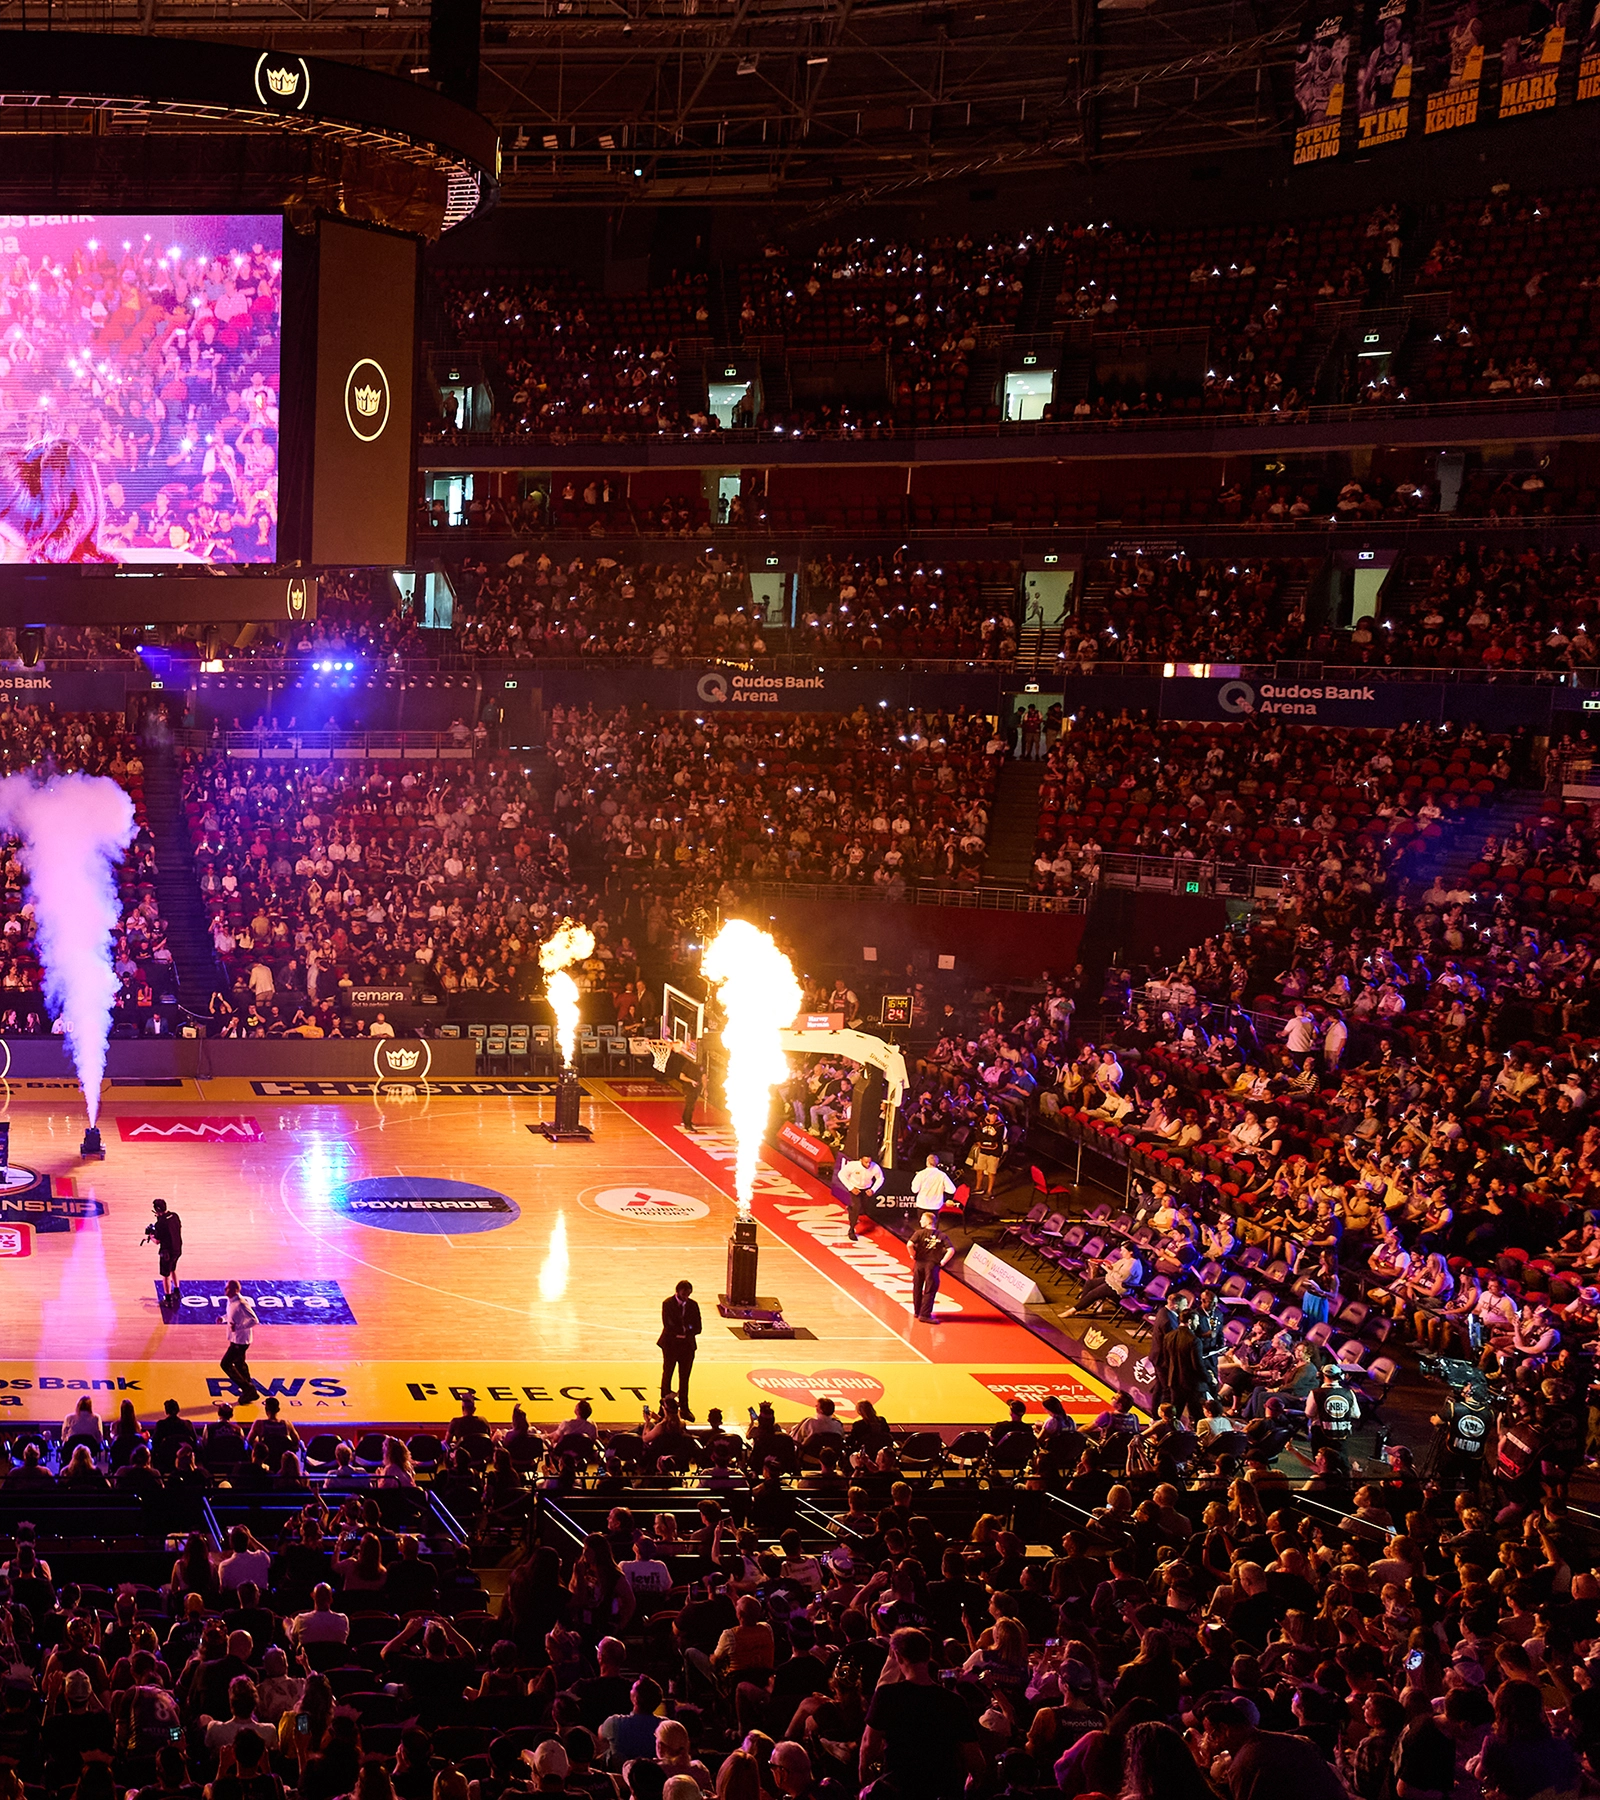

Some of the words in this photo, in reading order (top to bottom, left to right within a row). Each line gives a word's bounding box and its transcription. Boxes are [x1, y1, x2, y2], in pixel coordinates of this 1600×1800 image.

[1500, 73, 1559, 108] MARK
[1426, 87, 1479, 112] DAMIAN
[1498, 97, 1557, 119] DALTON
[1358, 106, 1409, 138] TIM
[1424, 101, 1479, 135] KEOGH
[1295, 122, 1341, 148] STEVE
[1357, 129, 1408, 150] MORRISSEY
[1293, 139, 1340, 165] CARFINO
[15, 677, 52, 689] Bank
[731, 675, 783, 688] Qudos
[785, 676, 825, 689] Bank
[731, 690, 778, 702] Arena
[1259, 684, 1324, 699] Qudos
[1325, 686, 1375, 701] Bank
[1259, 701, 1317, 715] Arena
[887, 1009, 905, 1020] 24
[26, 1080, 81, 1088] Ban
[349, 1083, 558, 1095] HOSTPLU
[128, 1123, 255, 1136] AAMI
[350, 1200, 493, 1209] POWERADE
[876, 1195, 896, 1208] 25
[180, 1295, 330, 1308] emara
[38, 1377, 143, 1390] Bank
[206, 1378, 348, 1397] RWS
[752, 1375, 882, 1391] MANGAKAHIA
[987, 1384, 1050, 1394] snap
[1051, 1385, 1084, 1394] 24/7
[406, 1383, 662, 1401] FREECIT
[154, 1702, 170, 1720] 8
